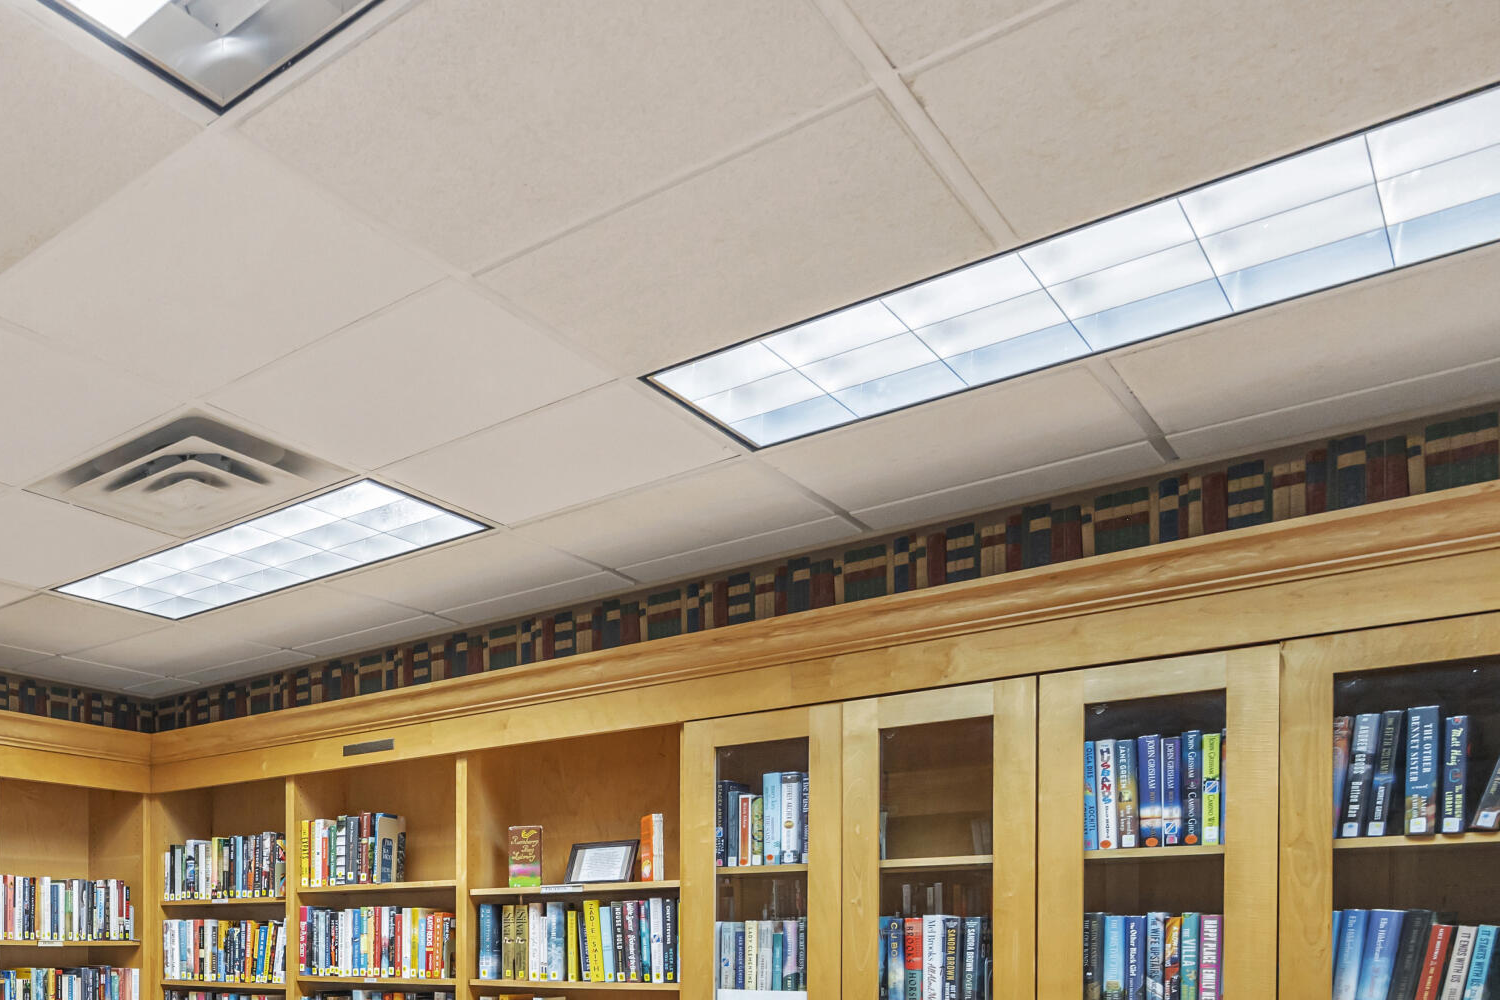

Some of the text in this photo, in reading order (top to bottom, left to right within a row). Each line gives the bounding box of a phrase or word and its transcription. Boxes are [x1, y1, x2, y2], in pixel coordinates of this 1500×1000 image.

[1353, 726, 1369, 774] ANDREW GROSS
[1409, 716, 1420, 782] BENNET SISTER
[1422, 723, 1433, 773] THE OTHER
[1446, 728, 1463, 766] Matt Haig
[1146, 739, 1156, 789] JOHN GRISHAM
[1166, 743, 1175, 789] JOHN GRISHAM
[1187, 792, 1196, 819] CAMINO
[1204, 920, 1218, 941] HAPPY
[946, 929, 956, 981] SANDRA BROWN
[1150, 929, 1160, 978] WIFE UPSTAIRS
[1181, 938, 1196, 967] VILLA
[1203, 943, 1217, 964] PLACE
[1459, 940, 1469, 956] ENDS
[1476, 938, 1489, 960] STARTS
[1202, 969, 1216, 991] EMILY
[1454, 957, 1465, 974] WITH
[1473, 961, 1485, 978] WITH
